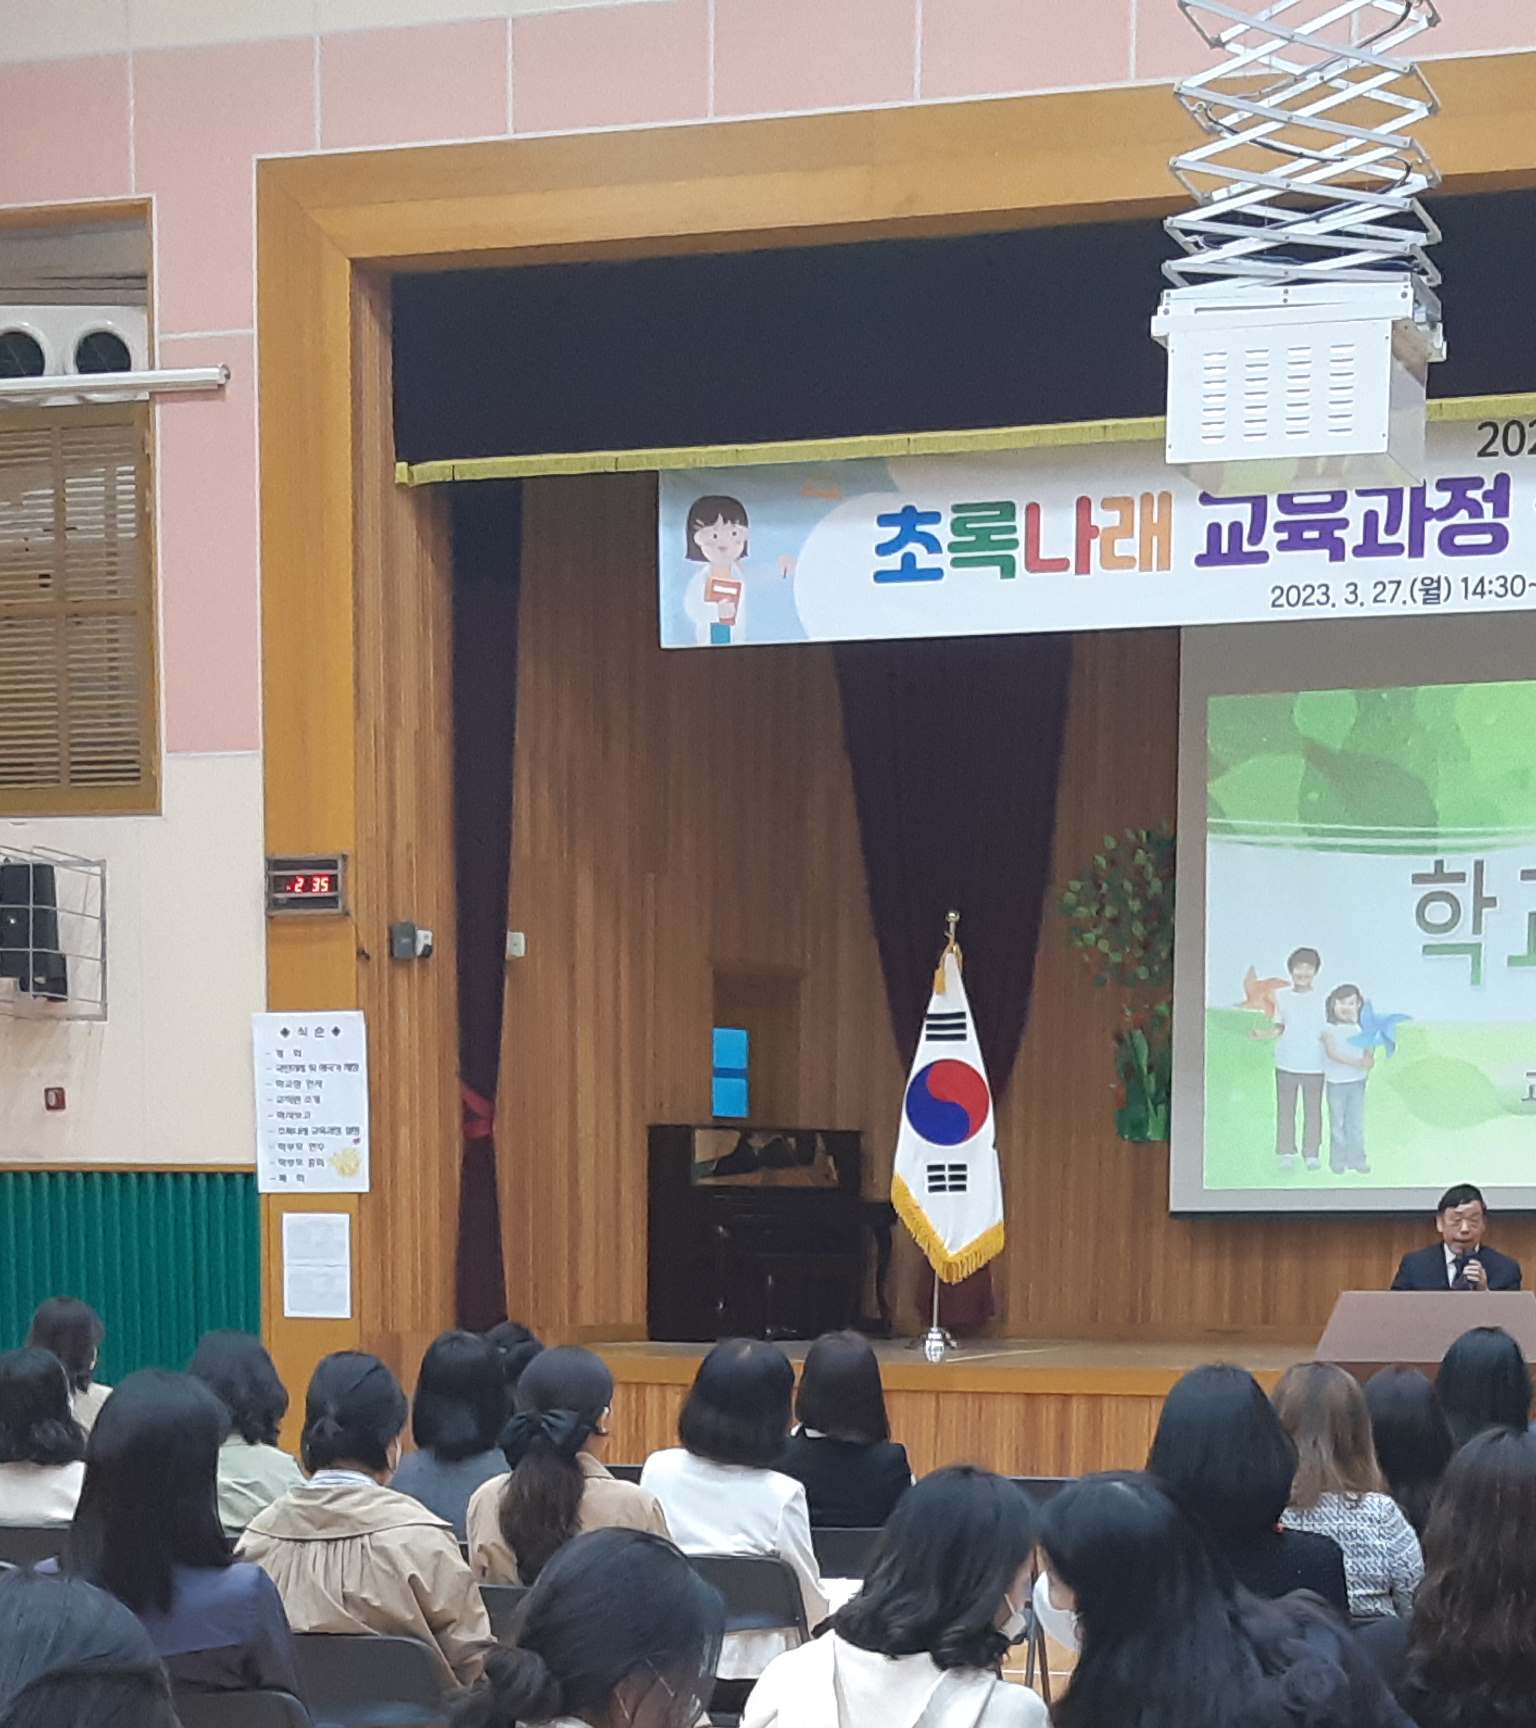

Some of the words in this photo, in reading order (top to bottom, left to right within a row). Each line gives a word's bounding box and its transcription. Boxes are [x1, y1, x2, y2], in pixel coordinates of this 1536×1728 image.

[872, 490, 1173, 585] 초록나래
[1194, 470, 1512, 568] 교육과정
[1270, 583, 1336, 609] 2023.
[1345, 582, 1364, 607] 3.
[1372, 573, 1451, 607] 27.(월)
